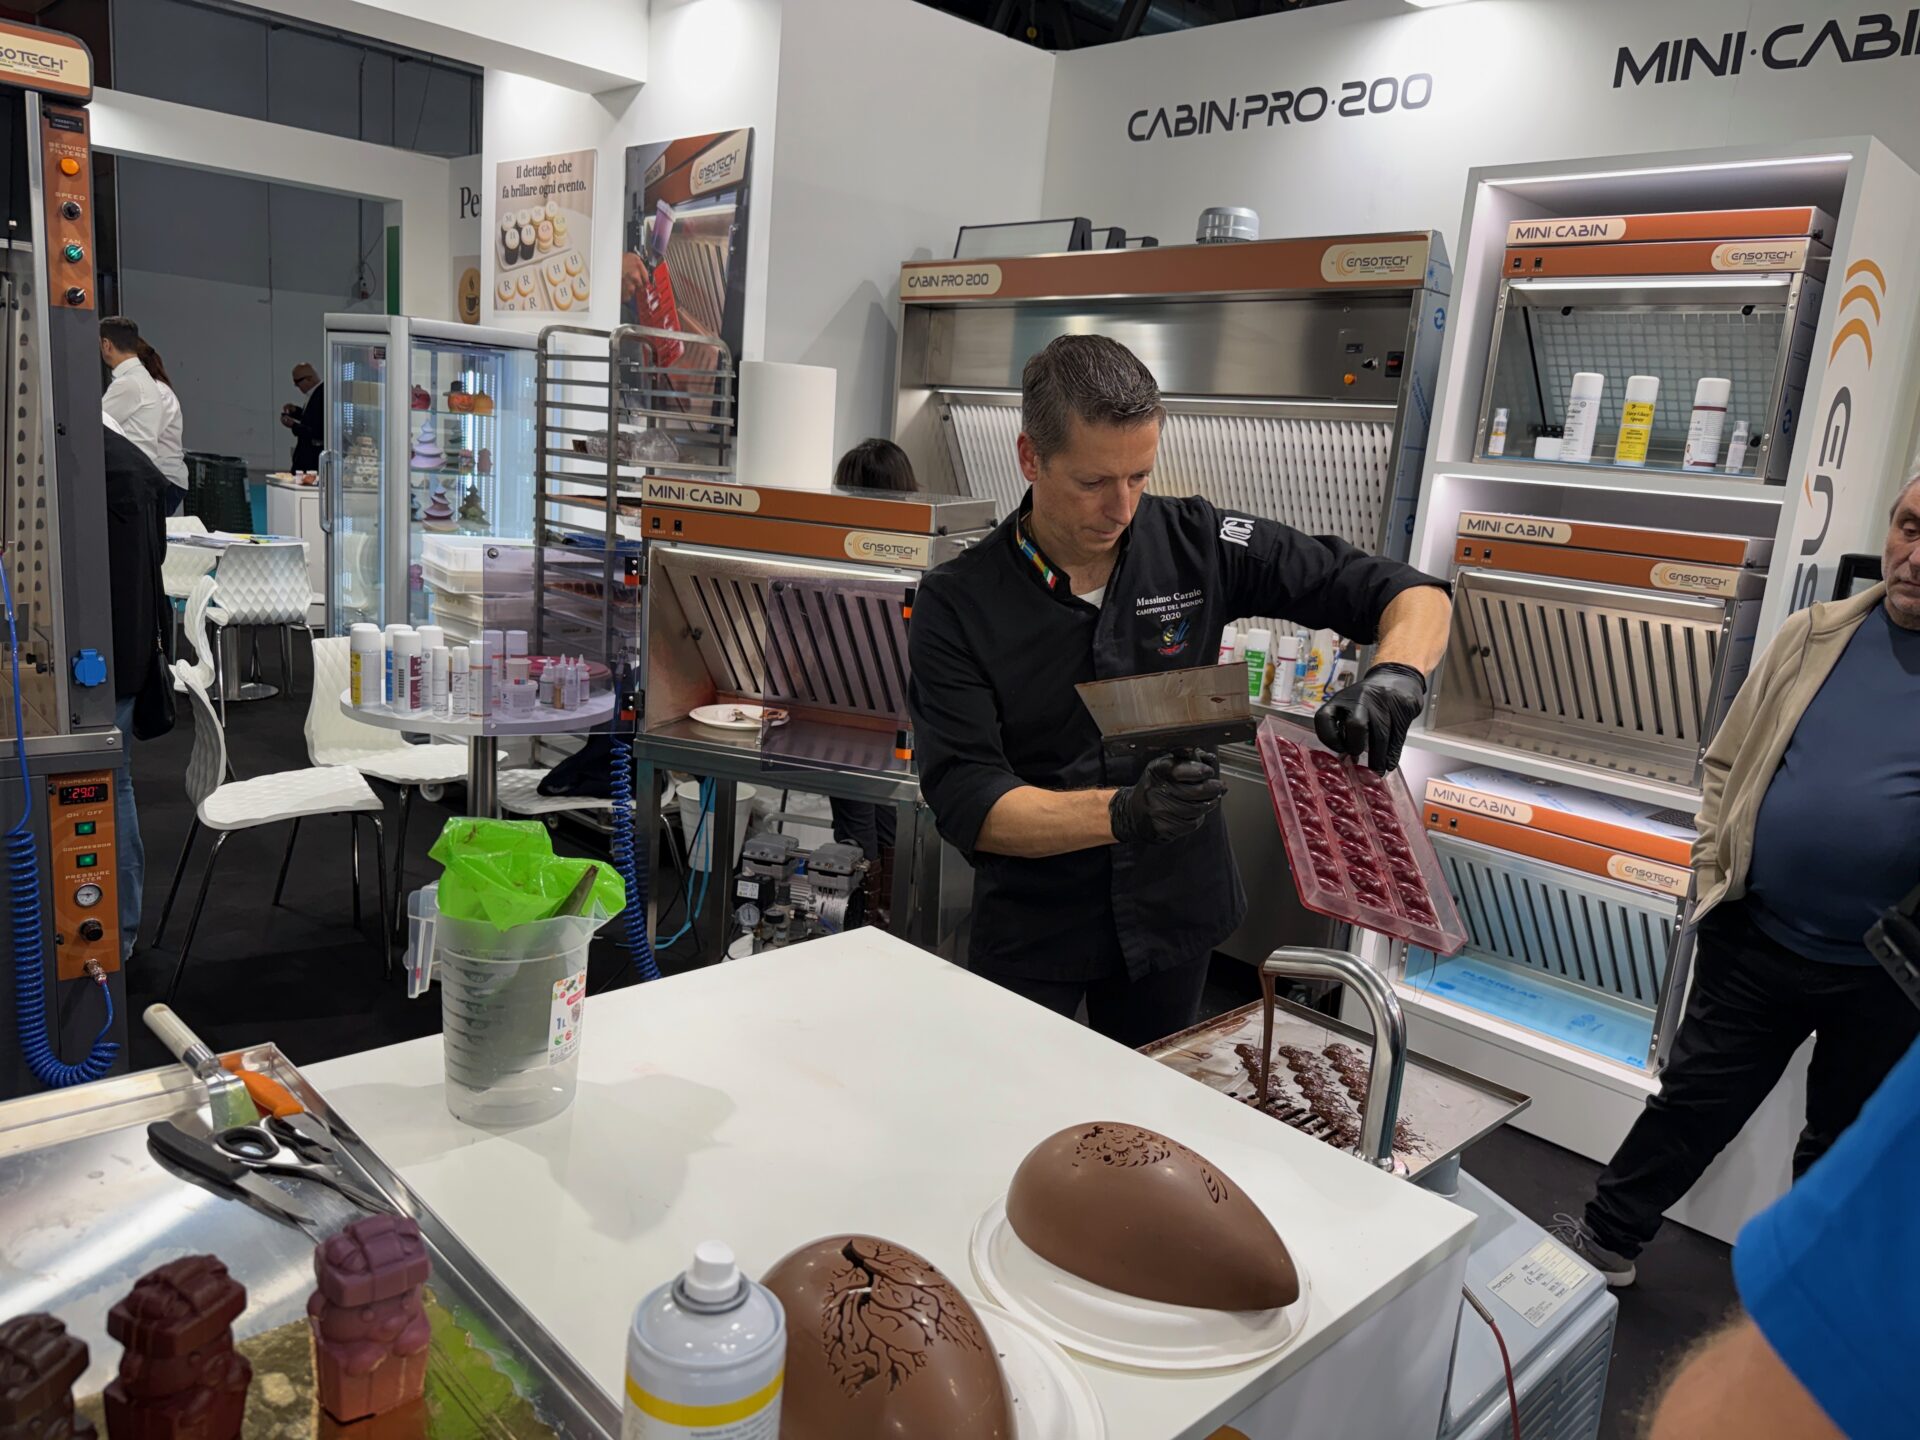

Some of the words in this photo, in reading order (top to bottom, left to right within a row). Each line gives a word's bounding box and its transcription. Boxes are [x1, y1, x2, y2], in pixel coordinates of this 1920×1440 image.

[48, 142, 88, 153] SERVICE
[49, 148, 88, 159] FILTERS
[516, 166, 522, 179] Il
[523, 162, 557, 180] dettaglio
[558, 160, 572, 174] che
[502, 186, 509, 198] fa
[510, 182, 538, 198] brillare
[539, 181, 556, 199] ogni
[557, 180, 586, 192] evento.
[55, 191, 86, 201] SPEED
[459, 186, 482, 220] Pe
[63, 237, 81, 245] FAN
[1346, 255, 1409, 267] ENSOTECH
[1731, 251, 1793, 261] ENSOTECH
[862, 542, 919, 556] ENSOTECH
[1668, 572, 1727, 587] ENSOTECH
[1136, 595, 1172, 607] Massimo
[1173, 588, 1202, 601] Carnio
[1136, 606, 1166, 616] CAMPIONE
[1180, 598, 1204, 609] MONDO
[1160, 611, 1182, 622] 2020
[59, 777, 110, 785] TEMPERATURE
[62, 842, 112, 852] COMPRESSOR
[65, 870, 110, 880] PRESSURE
[74, 875, 102, 883] METER
[1624, 865, 1679, 886] ENSOTECH
